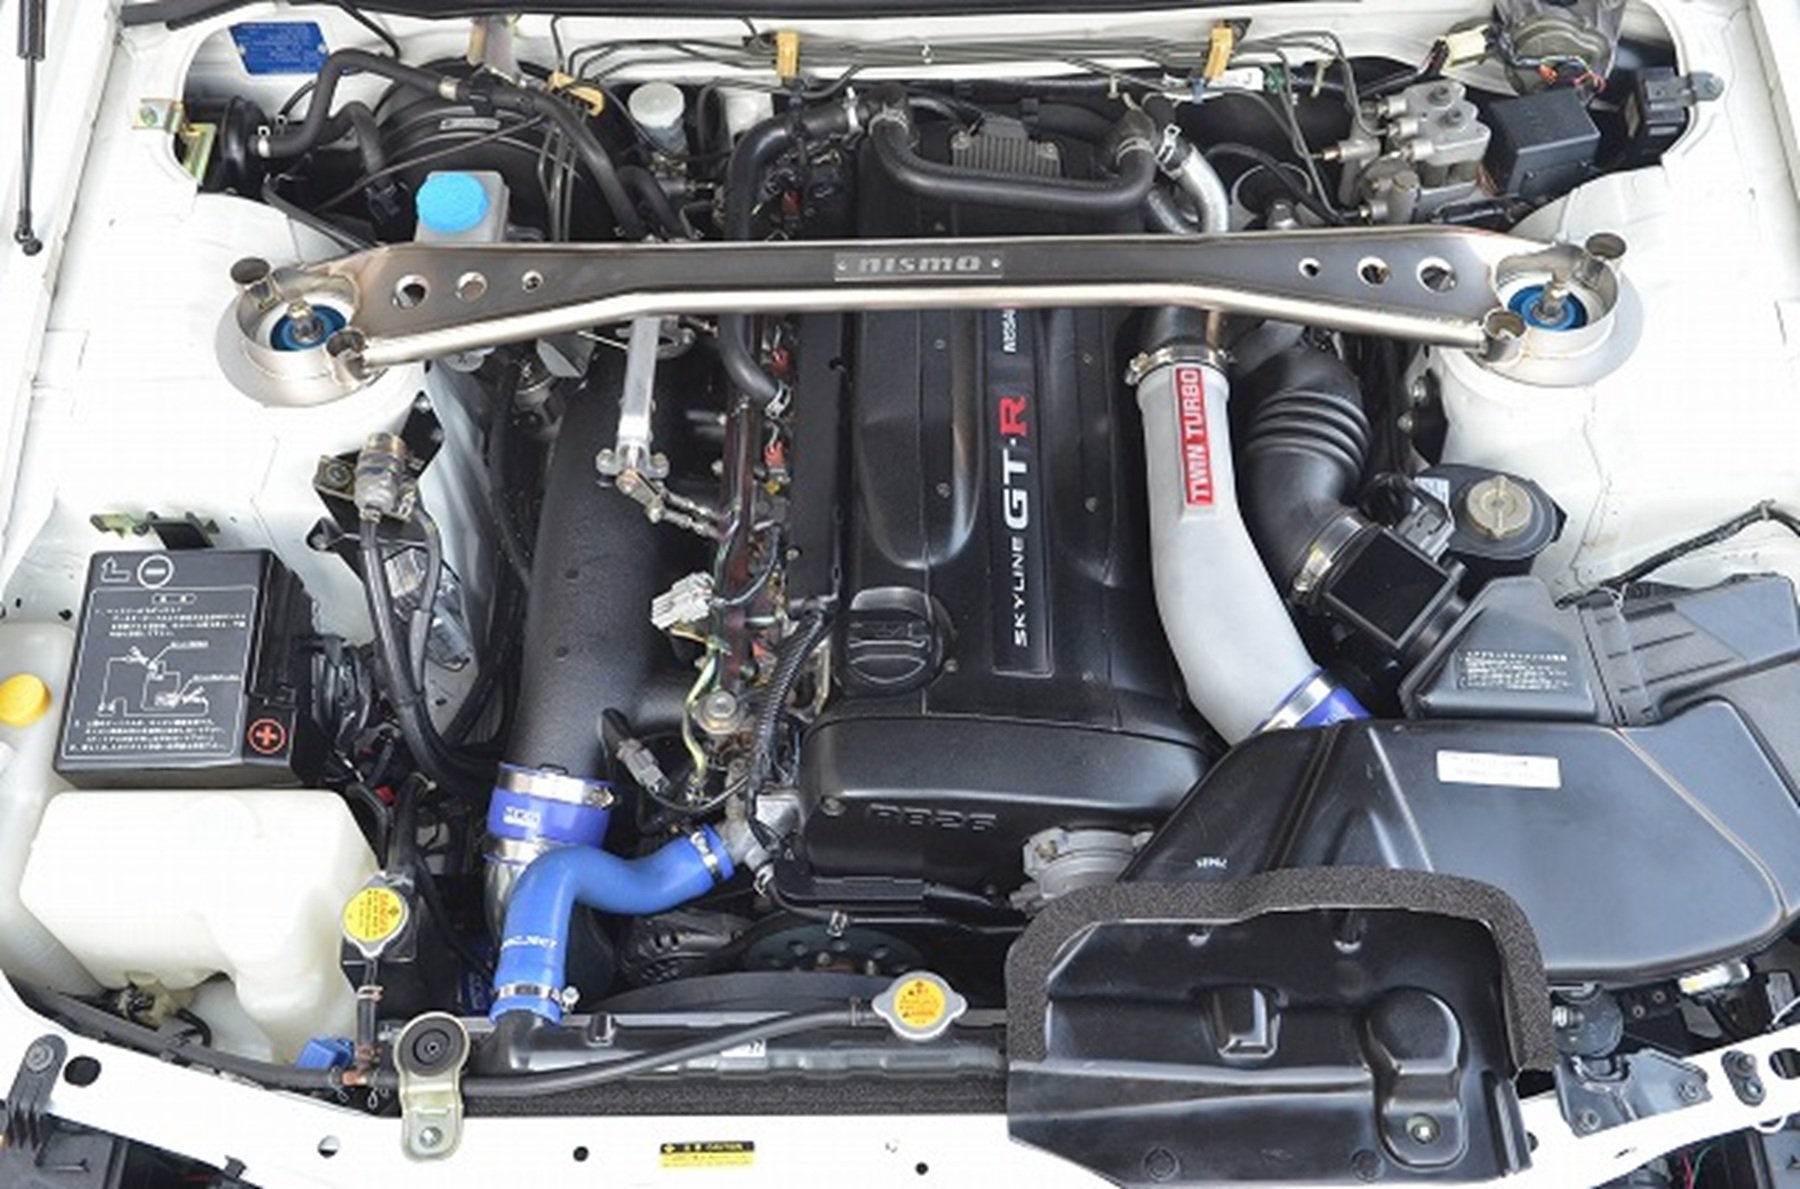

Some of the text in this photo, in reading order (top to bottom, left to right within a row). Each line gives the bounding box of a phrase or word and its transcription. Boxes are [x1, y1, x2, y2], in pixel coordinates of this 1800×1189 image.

[1180, 370, 1211, 502] TWIN TURBO
[1011, 536, 1028, 648] SKYLINE
